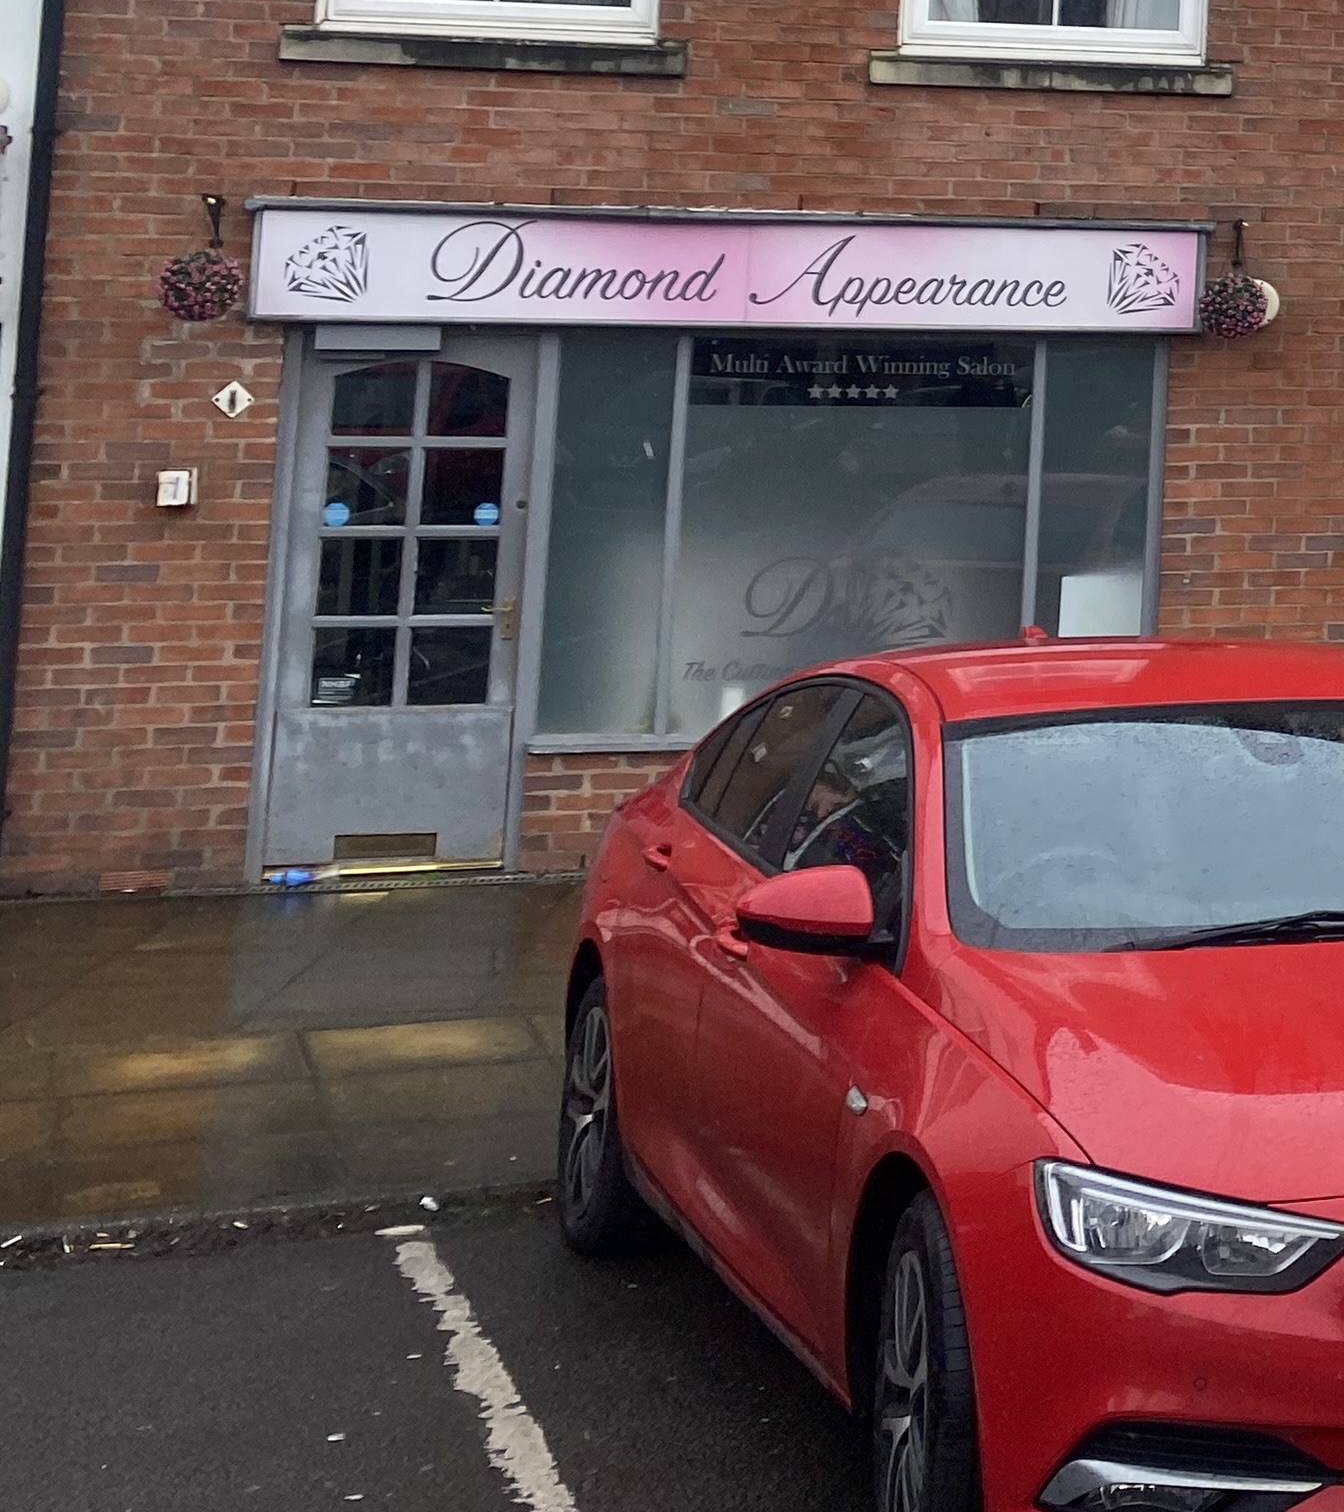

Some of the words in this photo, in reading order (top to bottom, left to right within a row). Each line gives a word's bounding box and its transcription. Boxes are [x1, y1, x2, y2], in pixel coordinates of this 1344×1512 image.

[426, 219, 726, 303] Diamond
[748, 234, 1068, 318] Appearance
[709, 353, 769, 374] Multi
[776, 354, 849, 375] Award
[856, 354, 951, 379] Winning
[956, 356, 1016, 377] Salon
[682, 659, 717, 682] The
